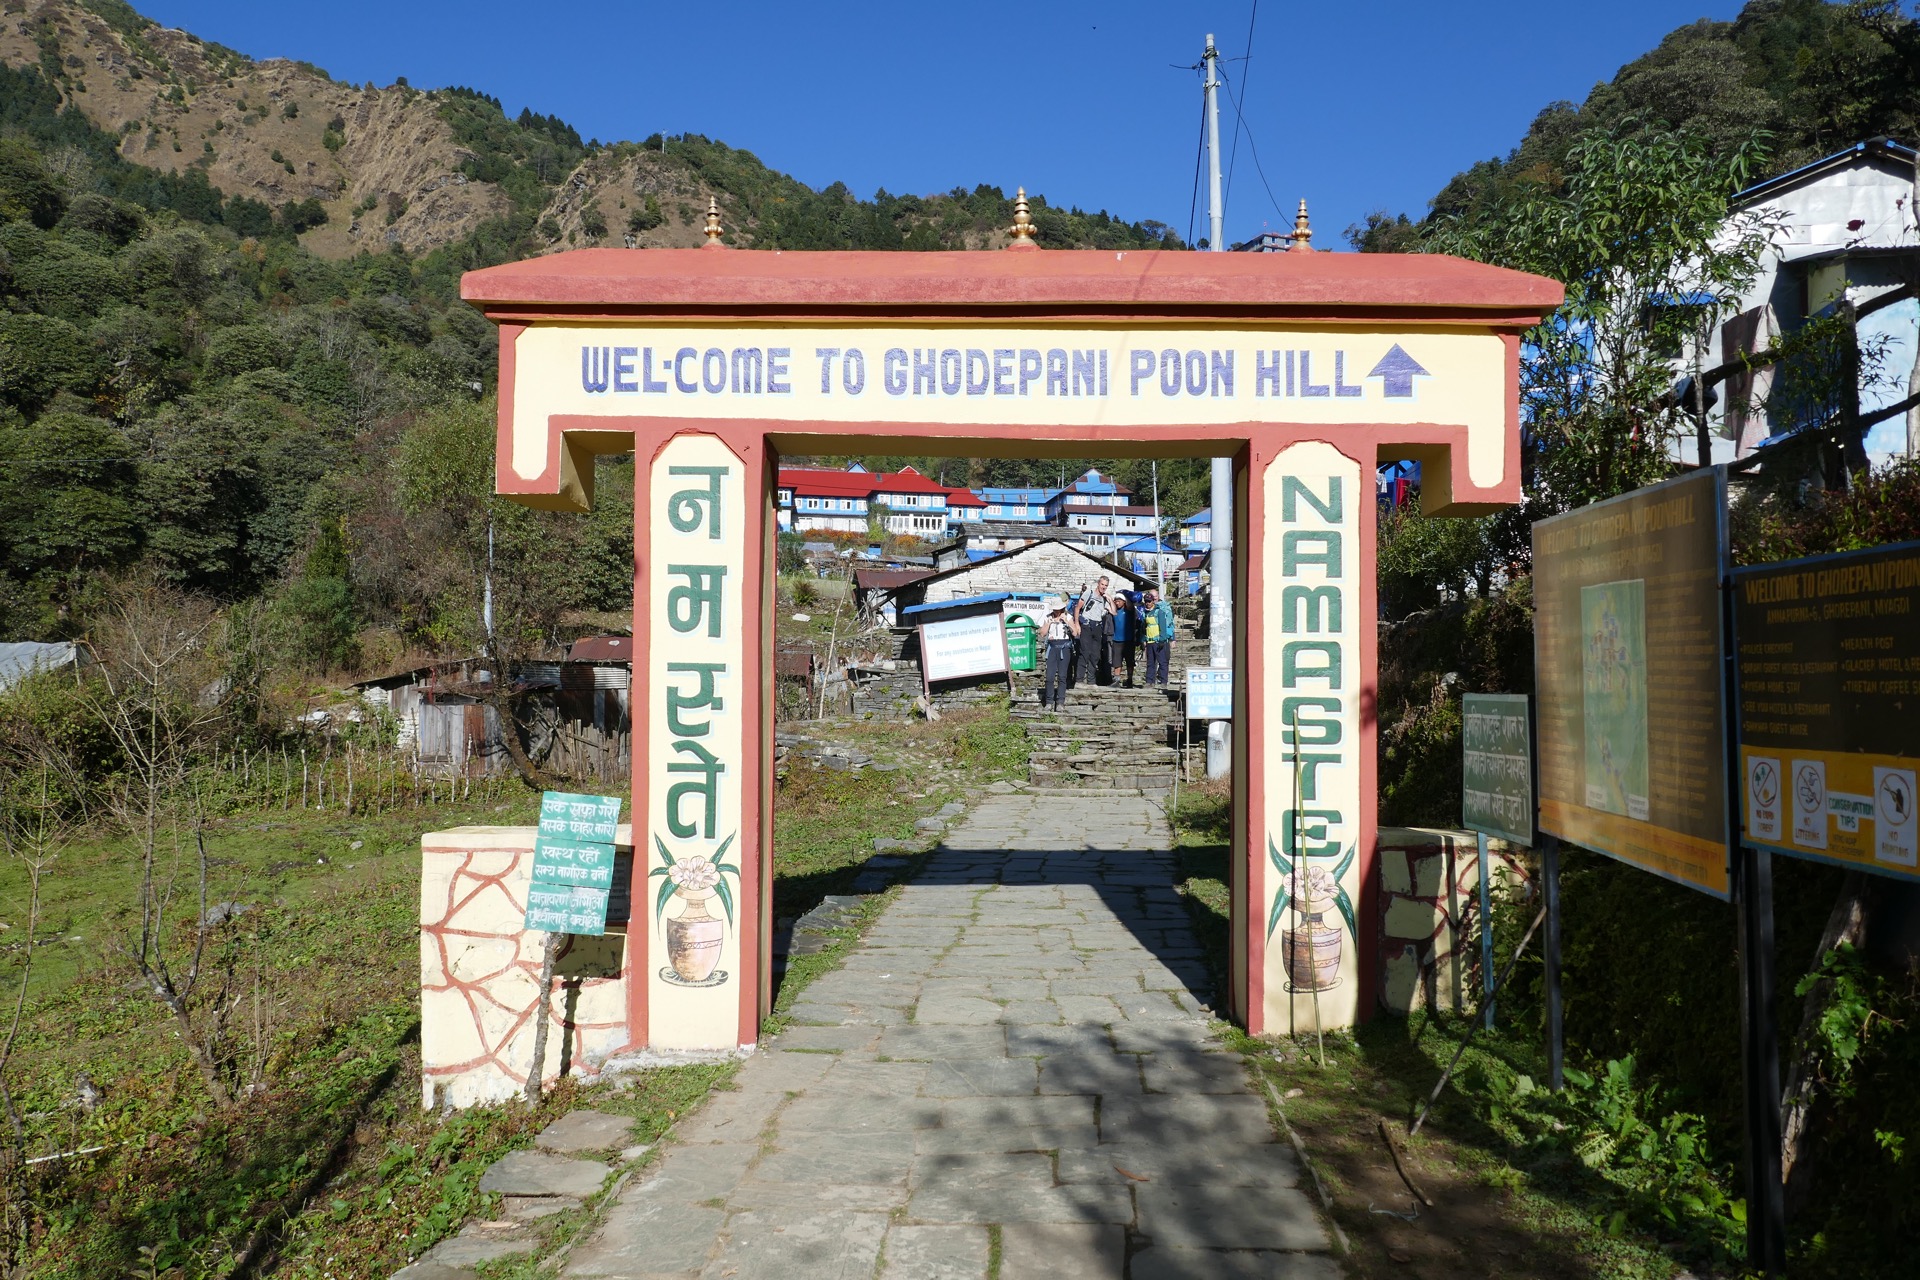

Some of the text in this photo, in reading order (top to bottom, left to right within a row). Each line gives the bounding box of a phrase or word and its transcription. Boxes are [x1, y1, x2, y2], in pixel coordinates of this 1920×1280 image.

[816, 347, 865, 395] TO
[883, 347, 1107, 397] GHODEPANI
[1131, 349, 1234, 397] POON
[1256, 349, 1362, 397] HILL
[1540, 529, 1577, 556] WELCOME
[1579, 522, 1591, 546] TO
[1745, 574, 1800, 604] WELCOME
[1802, 571, 1815, 598] TO
[1875, 597, 1910, 615] MYAGDI
[1844, 637, 1894, 651] HEALTH POST
[667, 466, 729, 839] नमस्ते
[1281, 475, 1343, 856] NAMASTE
[1845, 659, 1876, 672] GLACIER
[1879, 658, 1903, 672] HOTEL
[1191, 683, 1214, 693] TOURIST
[1785, 681, 1800, 694] STAY
[1846, 680, 1877, 693] TIBETAN
[1880, 680, 1910, 694] COFFEE
[1191, 695, 1225, 705] CHECK
[1769, 703, 1787, 714] HOTEL
[1828, 797, 1874, 816] CONSERVATION
[1839, 814, 1856, 828] TIPS
[1888, 830, 1899, 841] NO
